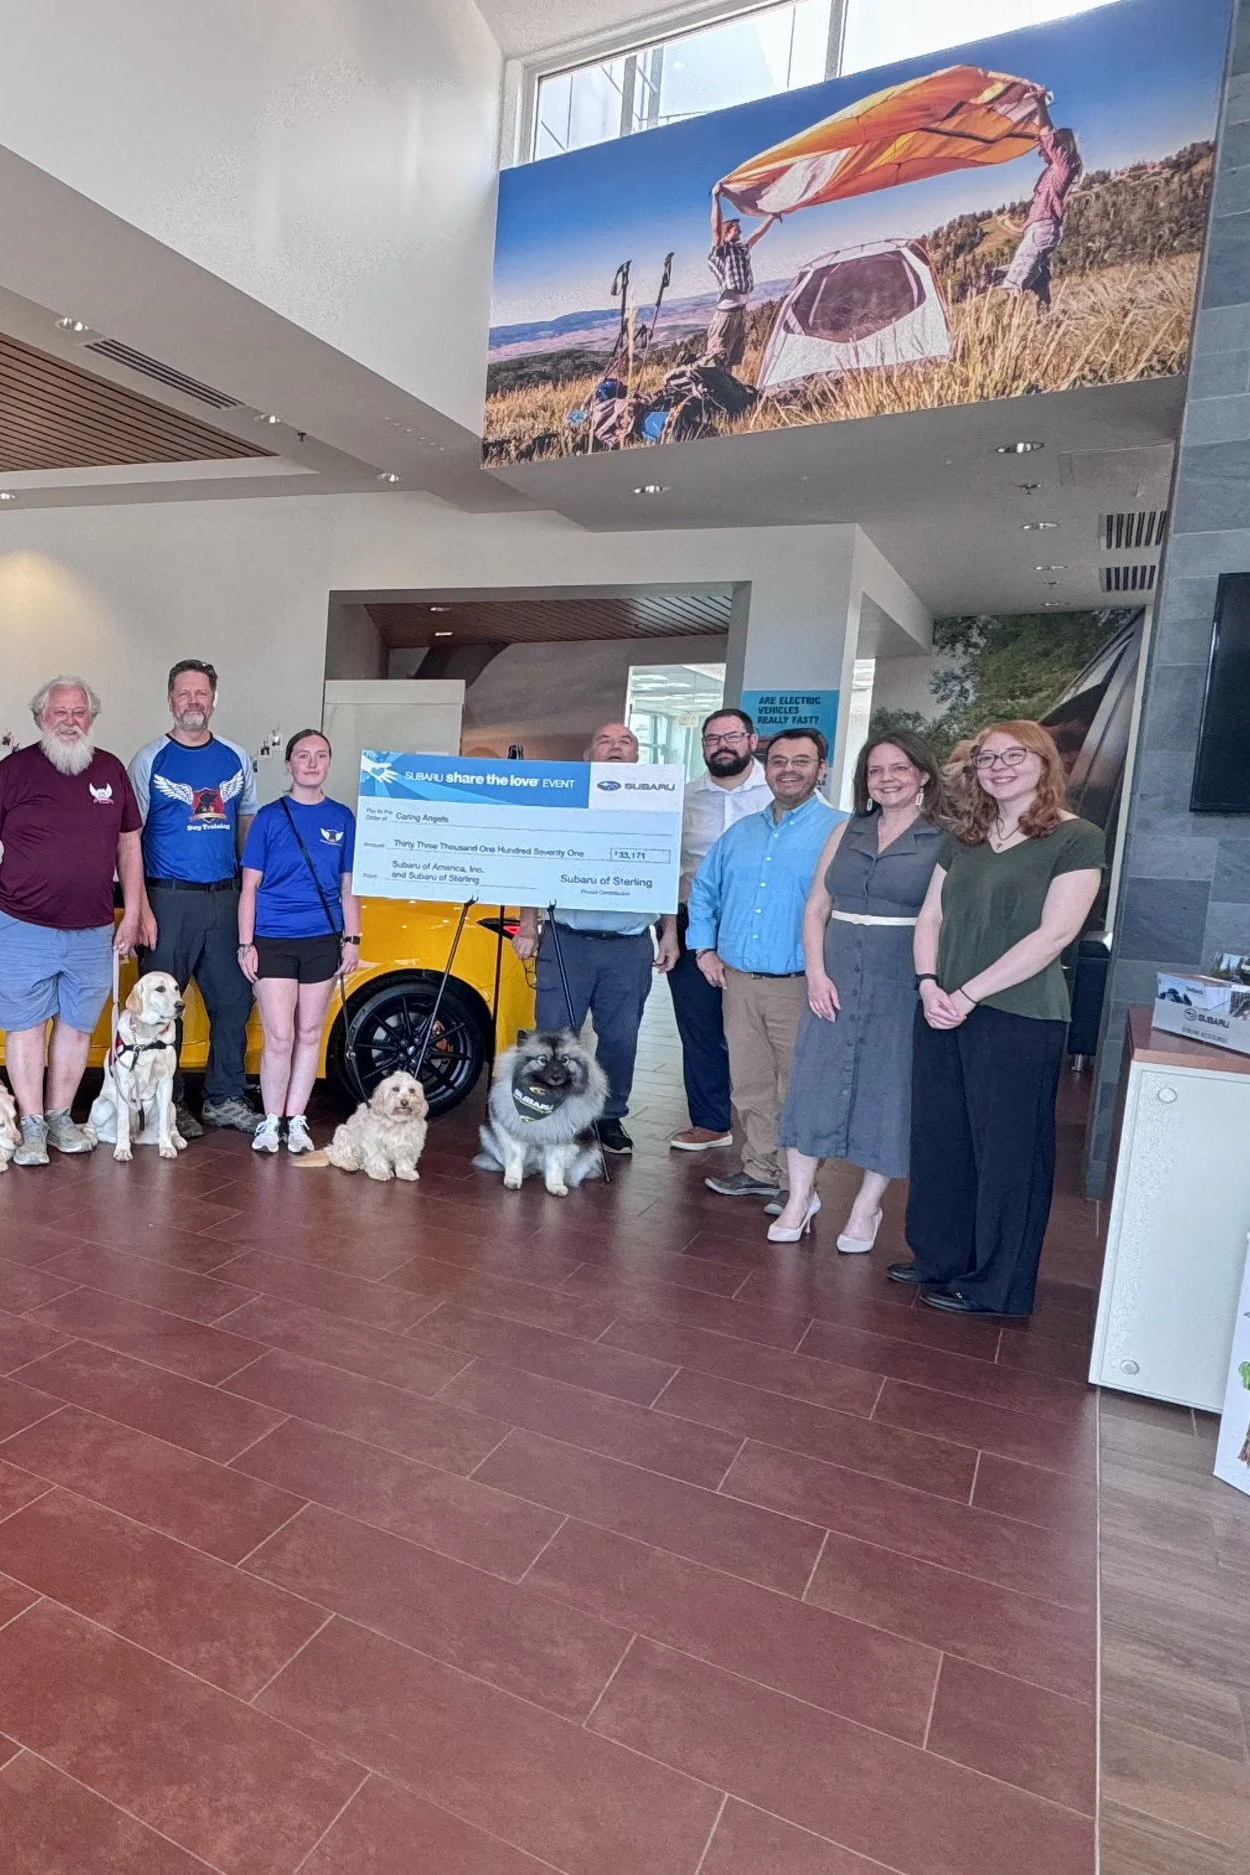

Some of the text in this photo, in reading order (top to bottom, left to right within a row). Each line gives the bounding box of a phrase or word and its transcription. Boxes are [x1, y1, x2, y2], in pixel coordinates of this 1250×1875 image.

[758, 697, 821, 705] ARE ELECTRIC
[758, 706, 799, 714] VEHICLES
[757, 716, 820, 725] REALLY FAST?
[404, 770, 575, 789] SUBARU share the love EVENT
[623, 782, 675, 792] SUBARU
[395, 811, 449, 824] Caring Angels
[202, 822, 231, 831] Training
[394, 838, 585, 858] Thirty Three Thousand One Hundred Seventy One
[392, 860, 485, 874] Subaru of America, Inc.
[391, 871, 480, 886] and Subaru of Sterling
[560, 873, 653, 889] Subaru of Sterling
[1197, 1013, 1230, 1029] SUBARU
